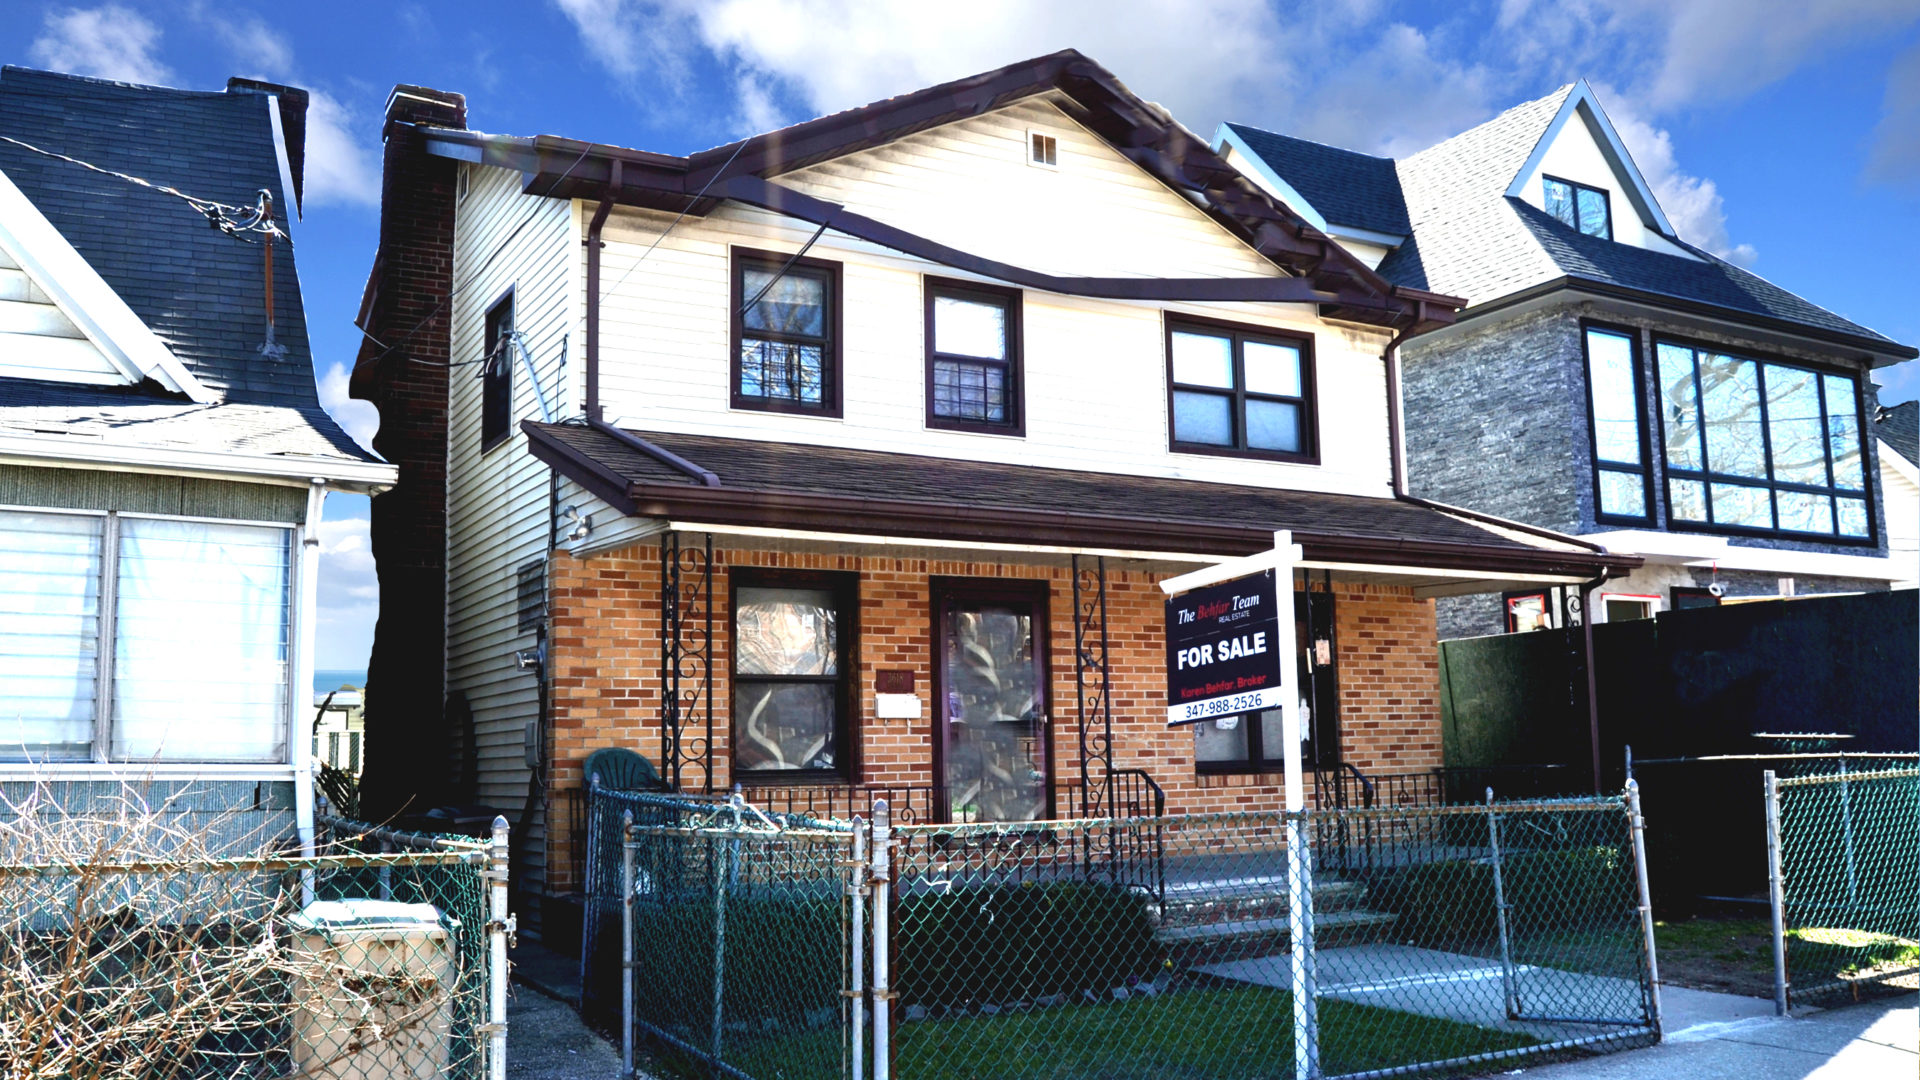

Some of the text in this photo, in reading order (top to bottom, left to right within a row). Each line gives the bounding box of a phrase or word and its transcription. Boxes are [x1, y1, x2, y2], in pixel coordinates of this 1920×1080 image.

[1178, 609, 1195, 625] The
[1232, 594, 1260, 611] Team
[1218, 610, 1251, 624] REAL ESTATE
[1178, 631, 1267, 670] FOR SALE
[1181, 687, 1205, 699] Karen
[1236, 674, 1267, 688] Broker
[1185, 693, 1263, 719] 347-988-2526
